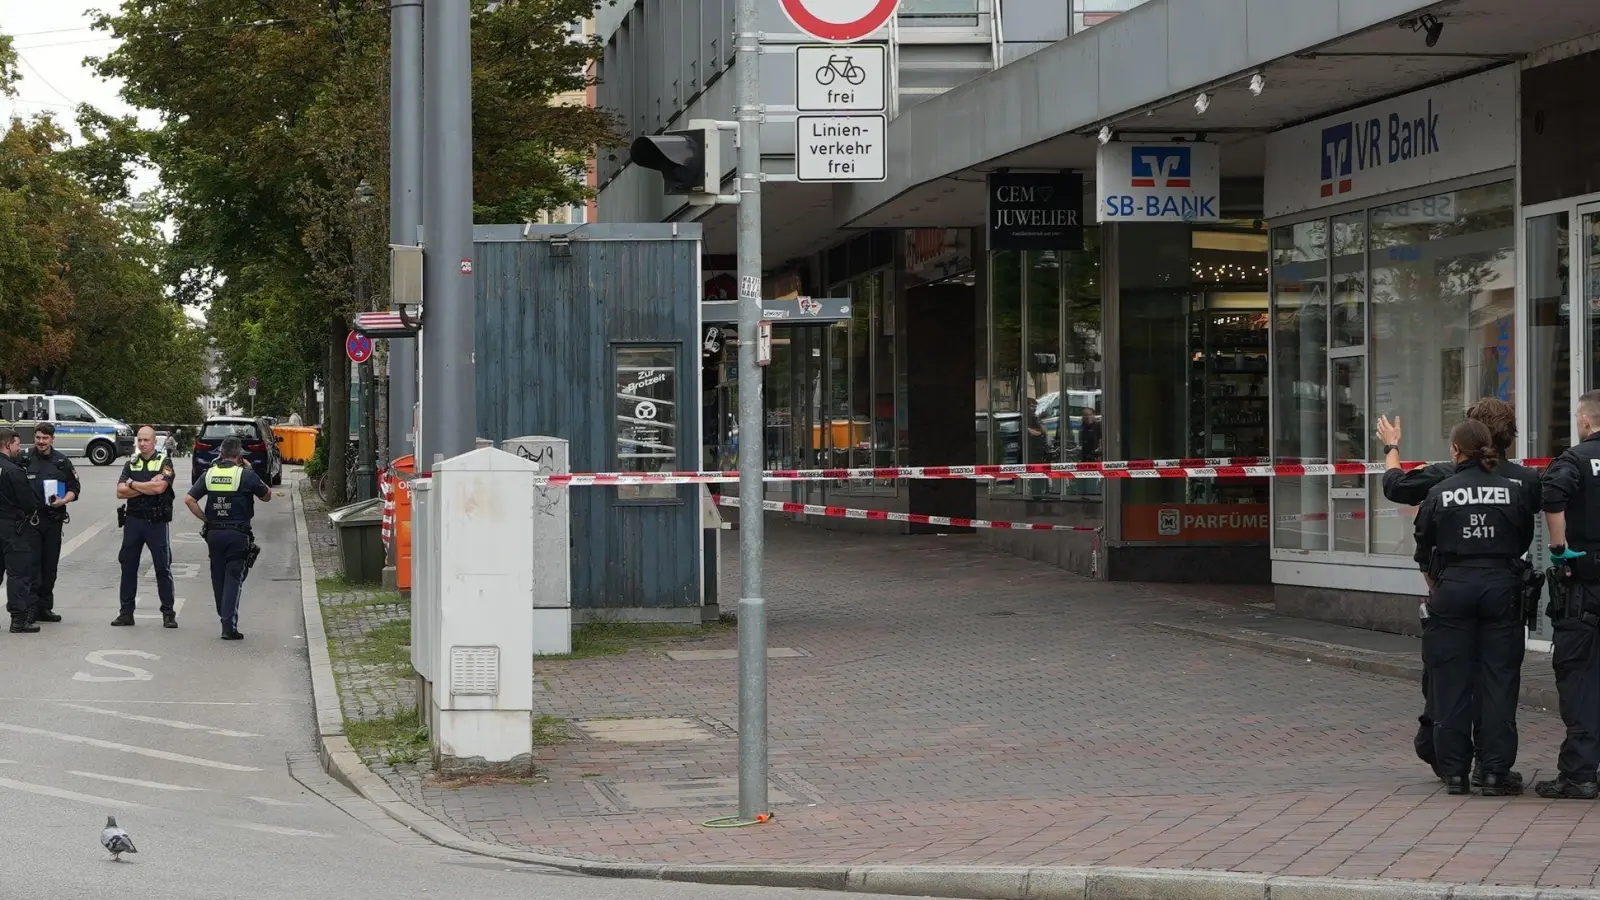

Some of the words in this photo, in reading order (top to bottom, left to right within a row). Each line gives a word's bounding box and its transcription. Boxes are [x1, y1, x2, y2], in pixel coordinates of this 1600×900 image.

[827, 89, 854, 103] frei
[813, 123, 869, 137] Linien-
[1355, 118, 1381, 170] VR
[1388, 98, 1439, 164] Bank
[810, 141, 872, 155] verkehr
[828, 159, 855, 173] frei
[996, 186, 1034, 203] CEM
[1106, 195, 1217, 217] SB-BANK
[994, 209, 1079, 230] JUWELIER
[637, 369, 655, 380] Zur
[627, 373, 666, 393] Brotzeit
[1441, 487, 1511, 508] POLIZEI
[1184, 512, 1269, 529] PARFÜME
[1470, 513, 1487, 526] BY
[1462, 526, 1495, 539] 5411
